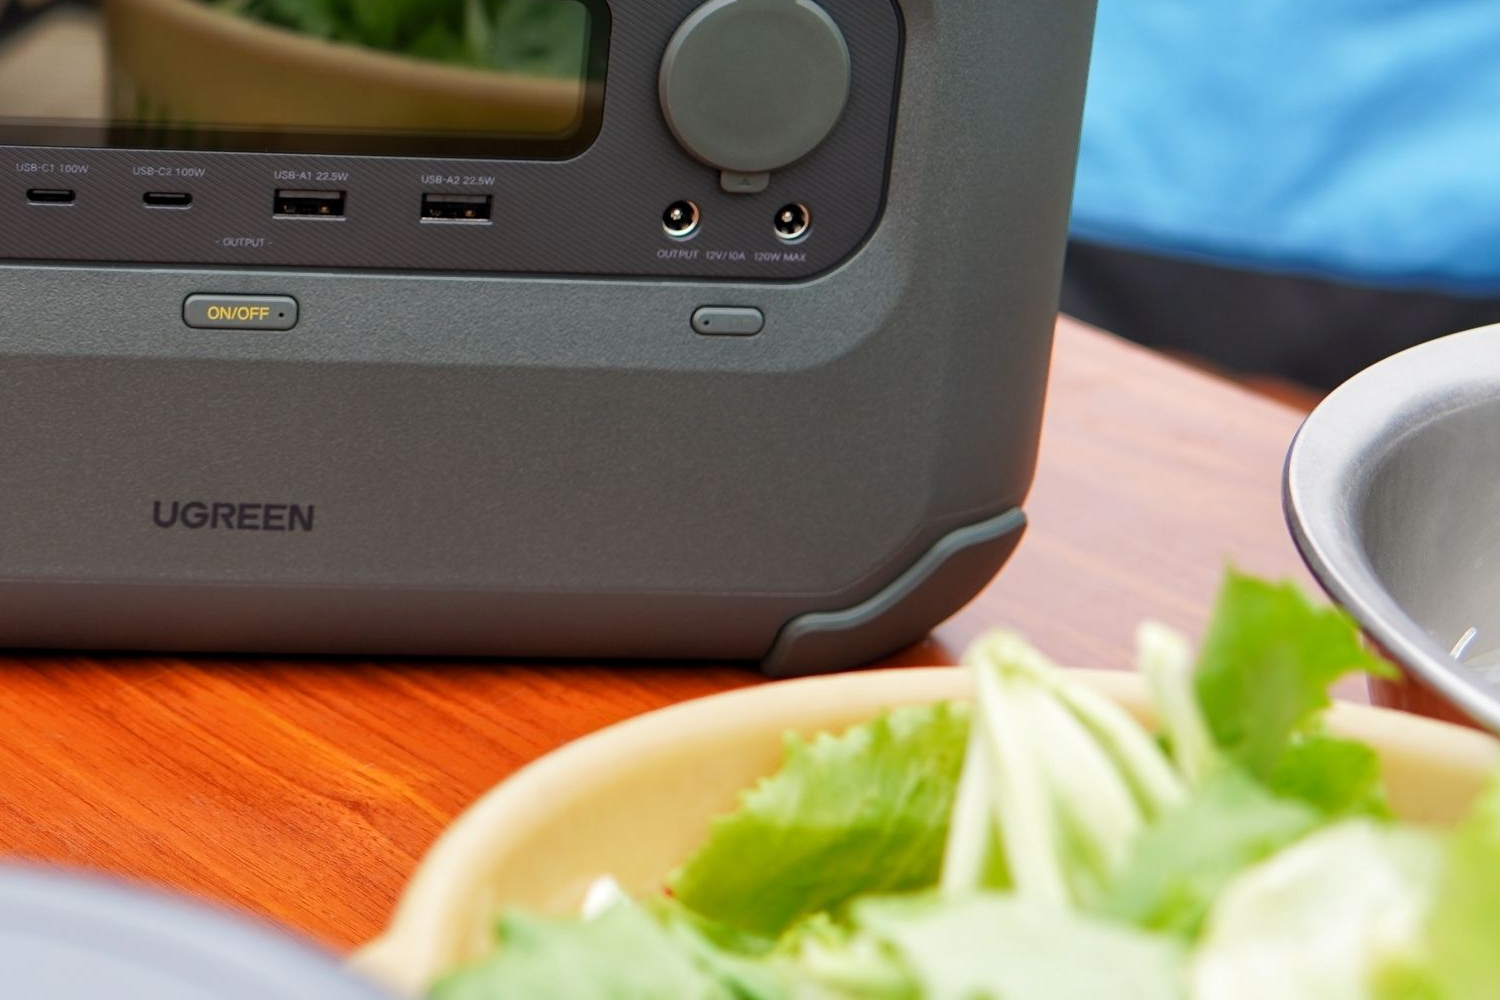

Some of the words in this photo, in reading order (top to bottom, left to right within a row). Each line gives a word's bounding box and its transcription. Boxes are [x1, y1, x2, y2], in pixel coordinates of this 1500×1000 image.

[15, 163, 55, 174] USB-C1
[59, 164, 90, 175] 100W
[132, 166, 173, 177] USB-C2
[176, 167, 206, 178] 100W
[273, 170, 312, 181] USB-A1
[315, 171, 349, 182] 22.5W
[421, 174, 460, 185] USB-A2
[463, 175, 496, 186] 22.5W
[656, 248, 699, 261] OUTPUT
[705, 250, 747, 262] 12V/10A
[754, 251, 781, 263] 120W
[782, 252, 807, 263] MAX
[206, 305, 271, 321] ON/OFF
[152, 500, 316, 532] UGREEN
